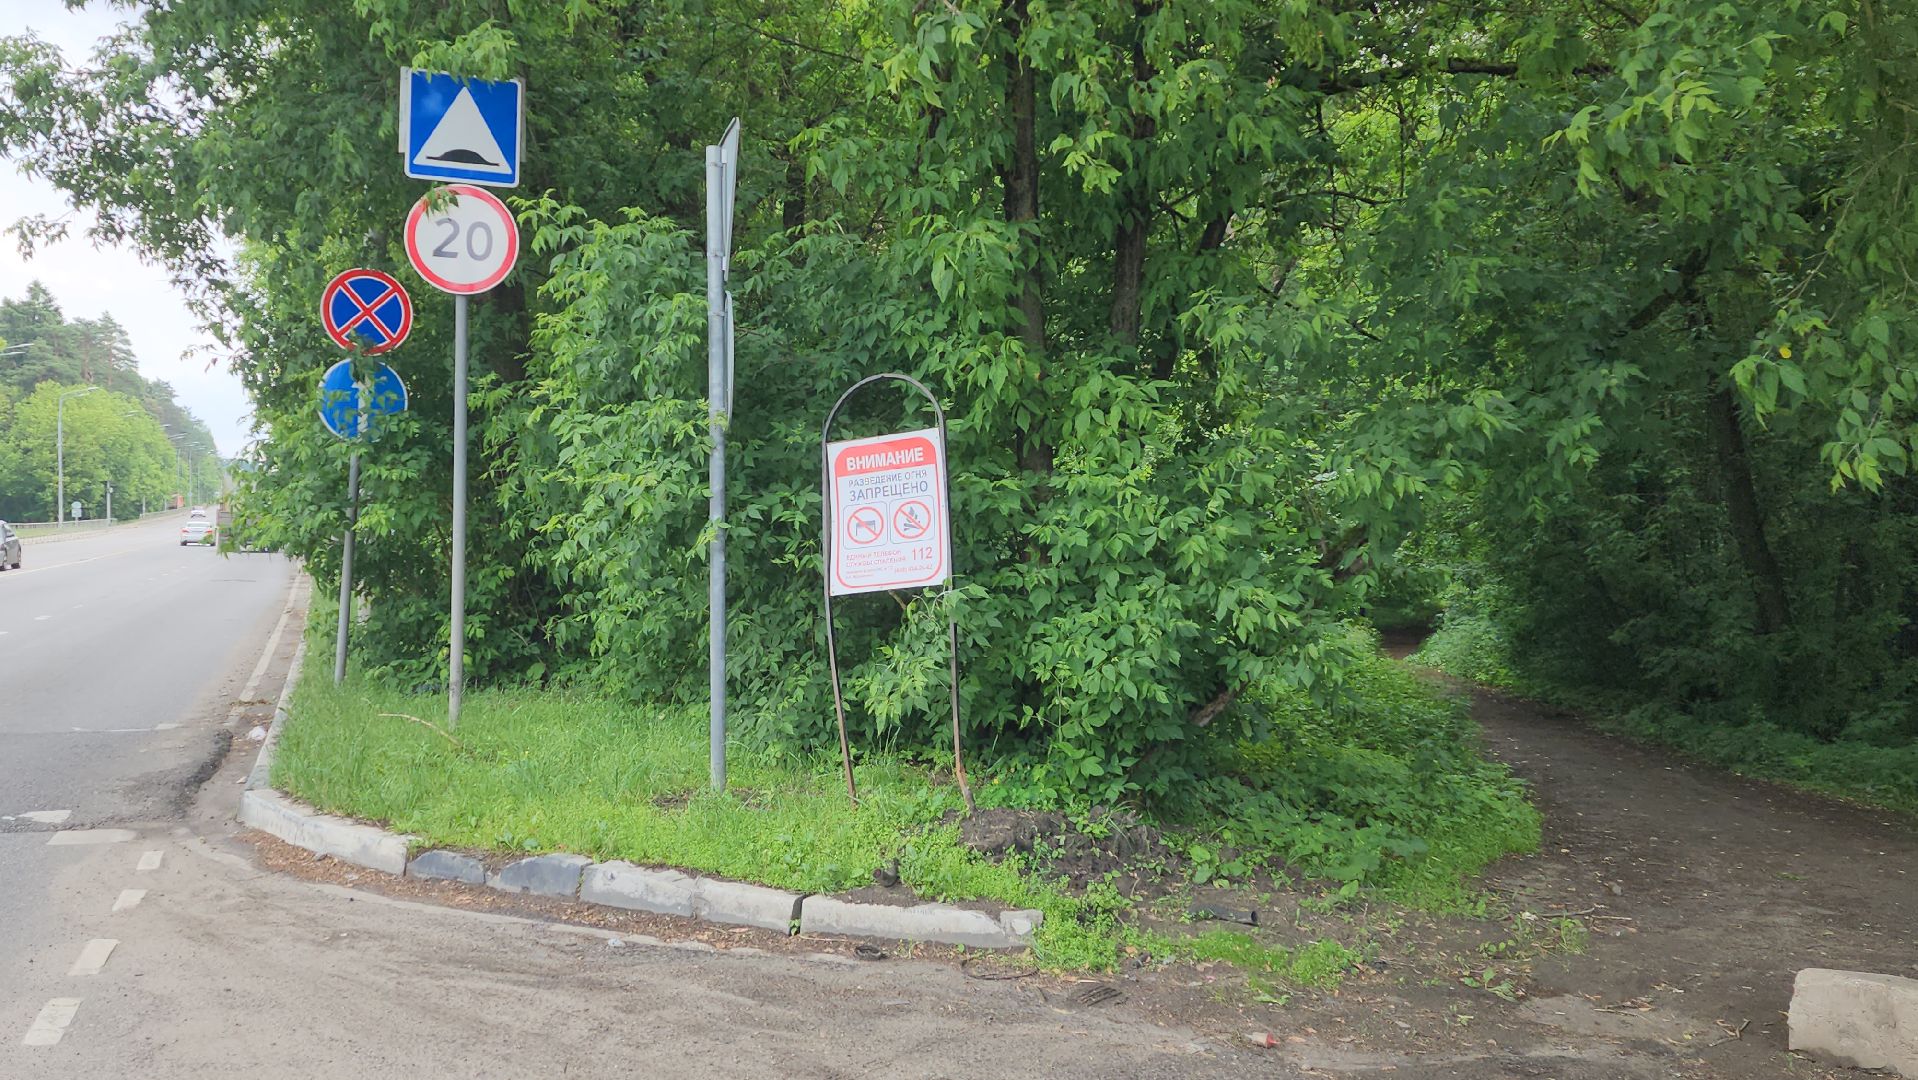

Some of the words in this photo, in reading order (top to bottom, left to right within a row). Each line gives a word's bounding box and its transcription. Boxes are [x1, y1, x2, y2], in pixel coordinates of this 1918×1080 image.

[432, 217, 493, 261] 20
[846, 447, 924, 471] ВНИМАНИЕ
[848, 472, 902, 488] РАЗВЕДЕНИЕ
[904, 470, 927, 479] ОГНЯ
[850, 480, 928, 502] ЗАПРЕЩЕНО
[912, 547, 933, 561] 112
